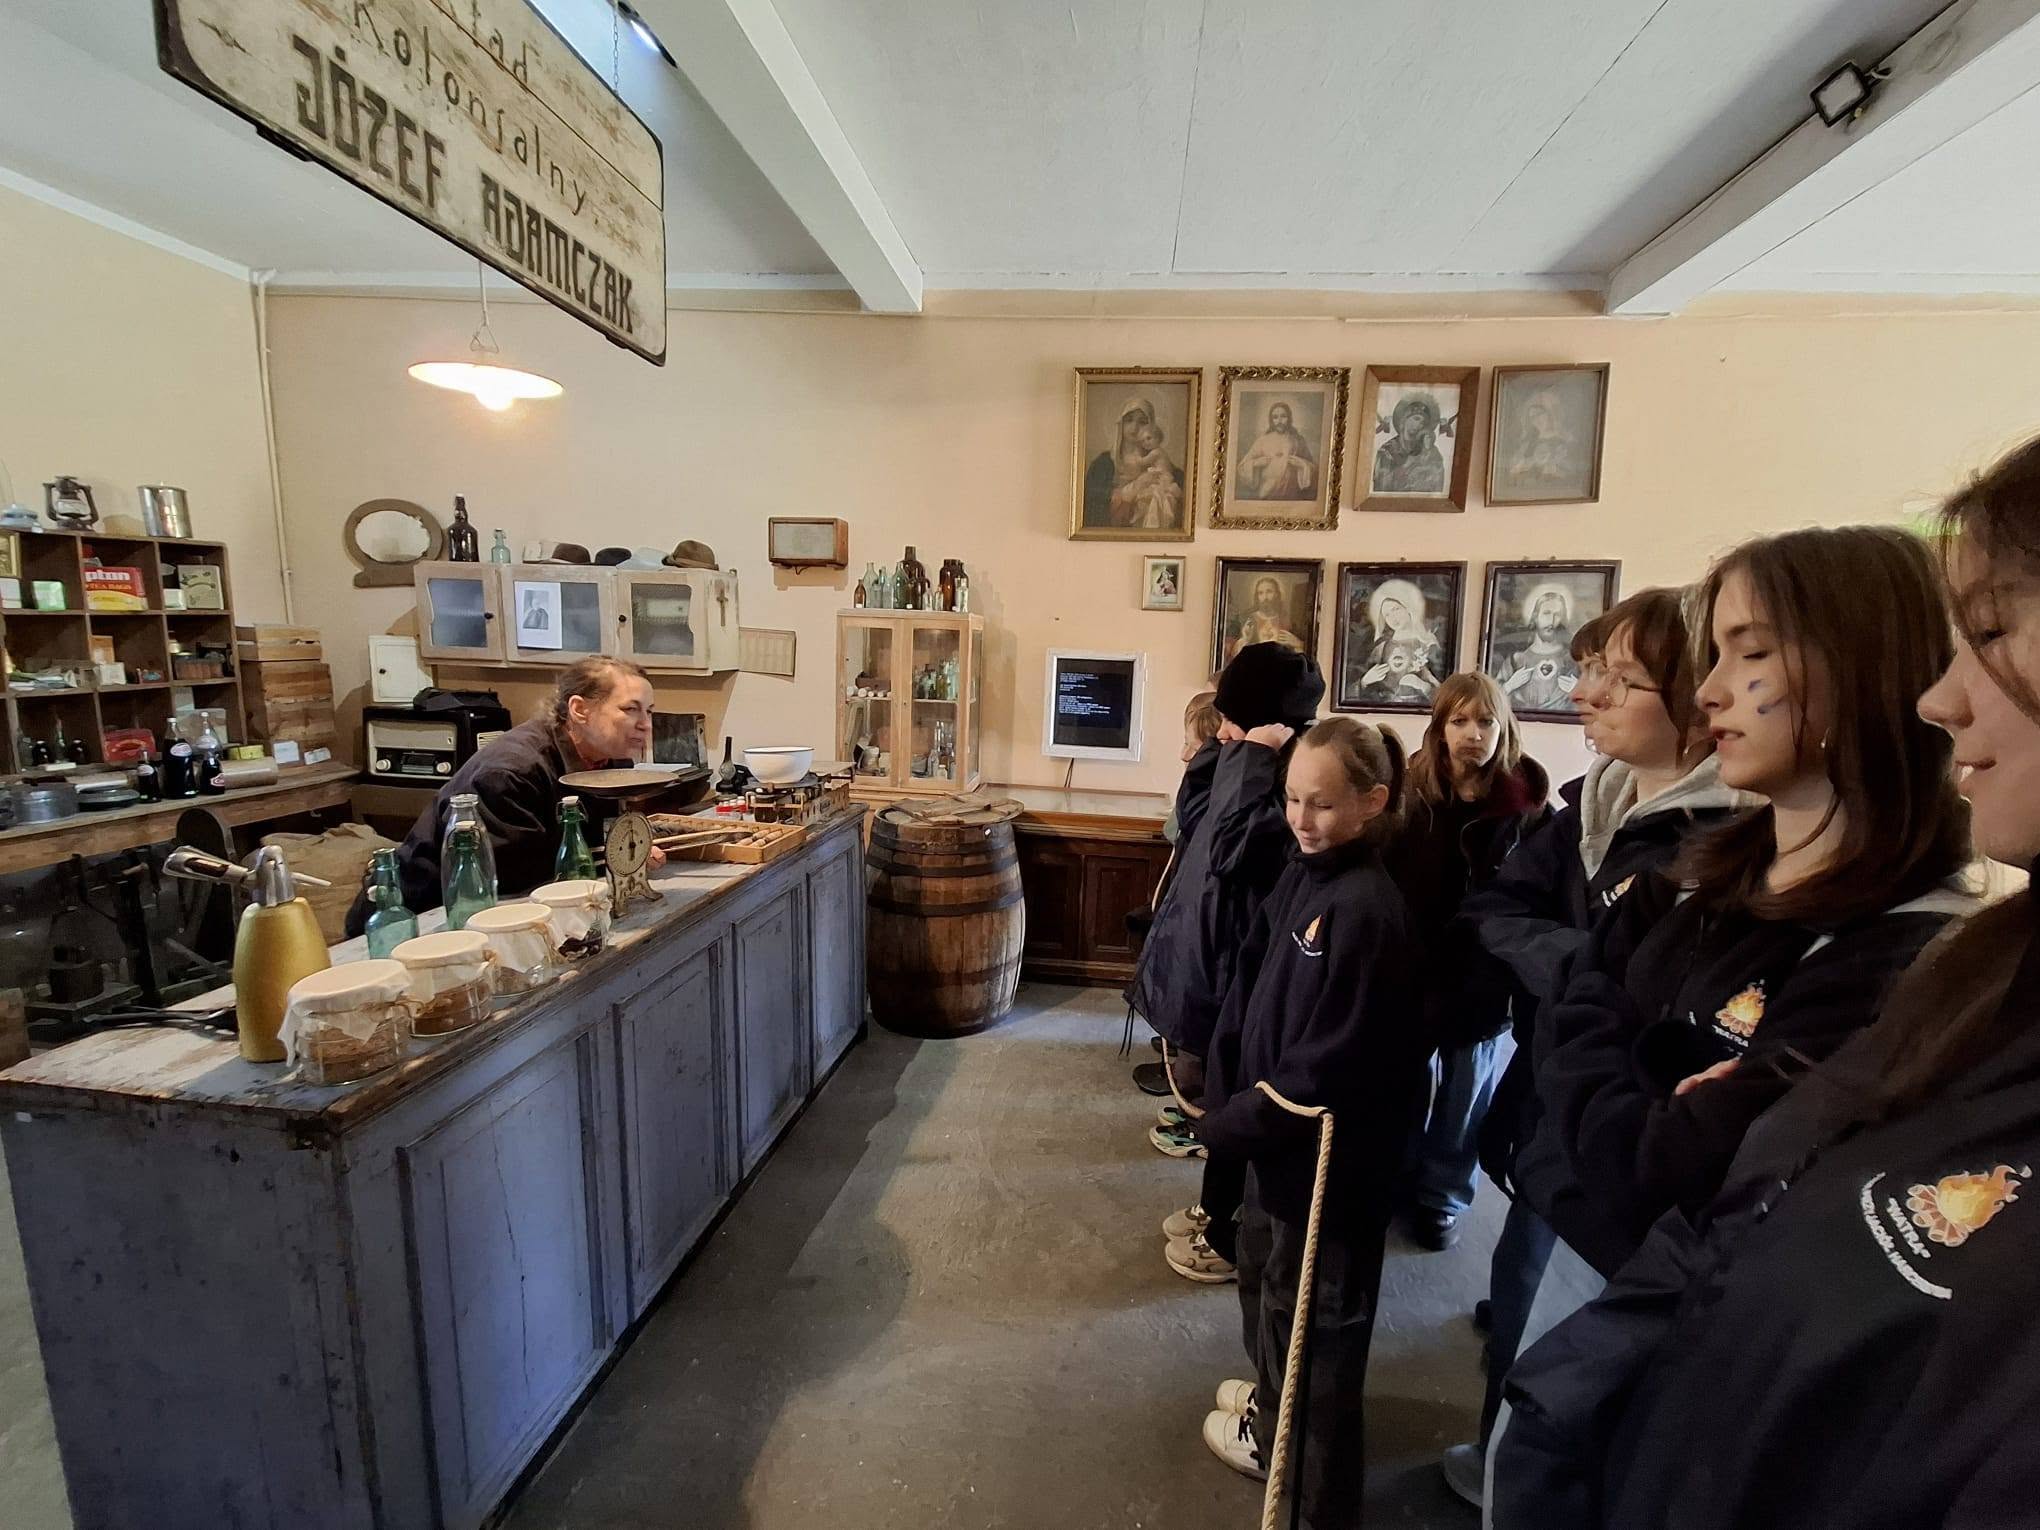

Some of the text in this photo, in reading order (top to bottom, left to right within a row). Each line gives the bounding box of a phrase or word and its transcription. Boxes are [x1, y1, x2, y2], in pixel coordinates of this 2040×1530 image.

[448, 0, 529, 85] ład
[292, 33, 634, 334] JÓZEF ADAMCZAK
